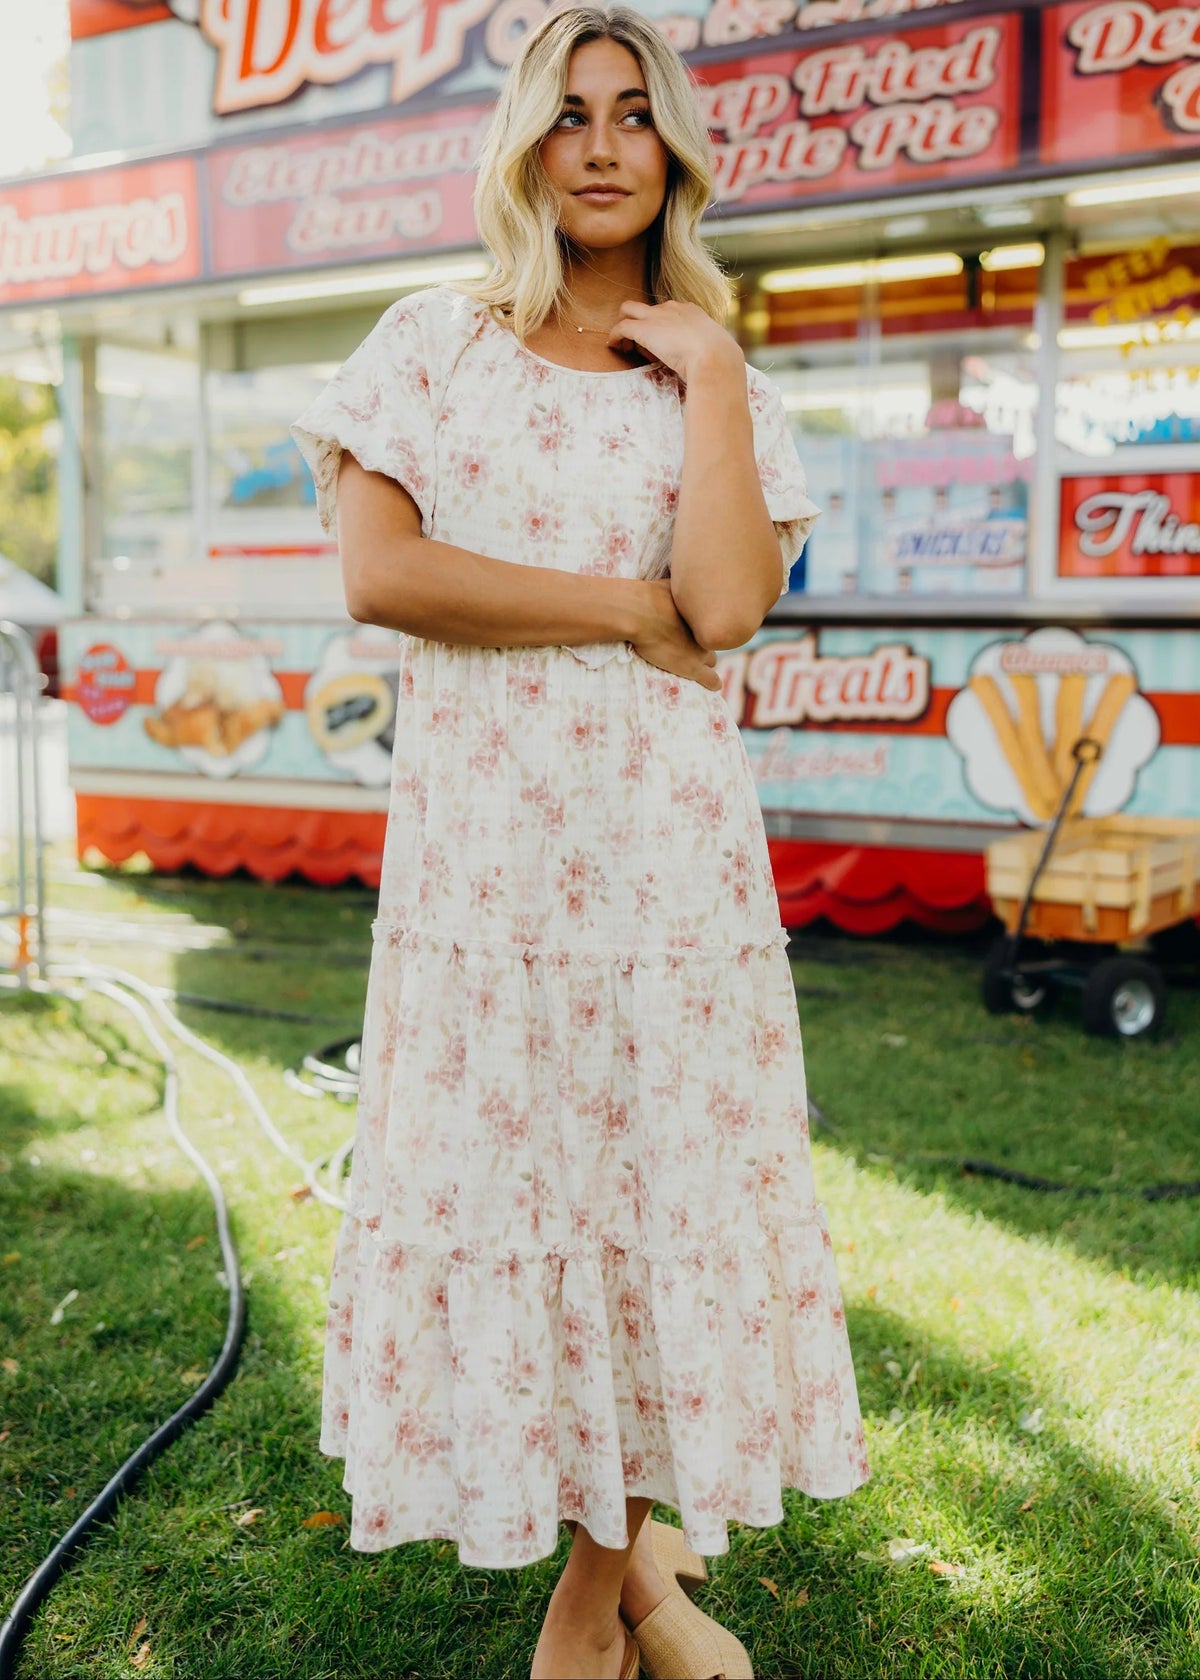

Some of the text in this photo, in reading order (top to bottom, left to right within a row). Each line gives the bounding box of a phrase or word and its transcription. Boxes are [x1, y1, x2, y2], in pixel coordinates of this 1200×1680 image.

[794, 27, 998, 115] Fried
[1066, 0, 1200, 74] De
[224, 124, 495, 206] Elephan
[703, 98, 998, 200] ple Pie
[0, 192, 188, 284] hurros
[286, 188, 442, 253] Ears
[746, 634, 930, 725] Treats
